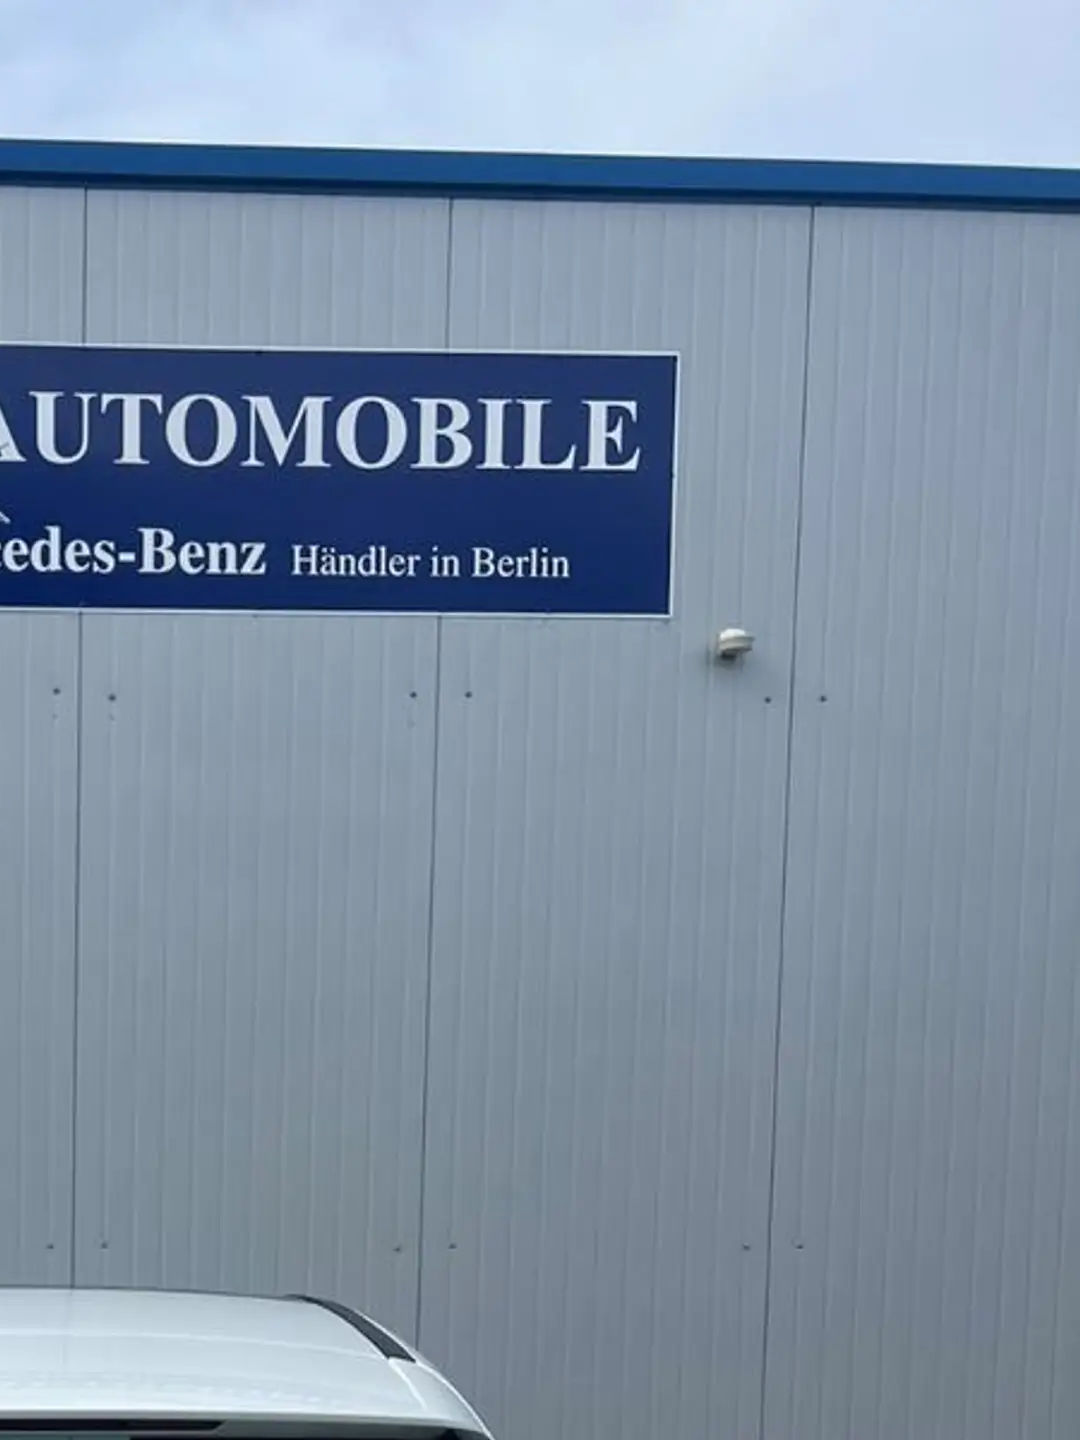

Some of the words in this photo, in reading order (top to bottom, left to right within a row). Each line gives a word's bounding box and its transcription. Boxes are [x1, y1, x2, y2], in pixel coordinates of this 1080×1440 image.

[291, 544, 421, 578] Händler
[431, 548, 461, 577] in
[471, 547, 571, 579] Berlin
